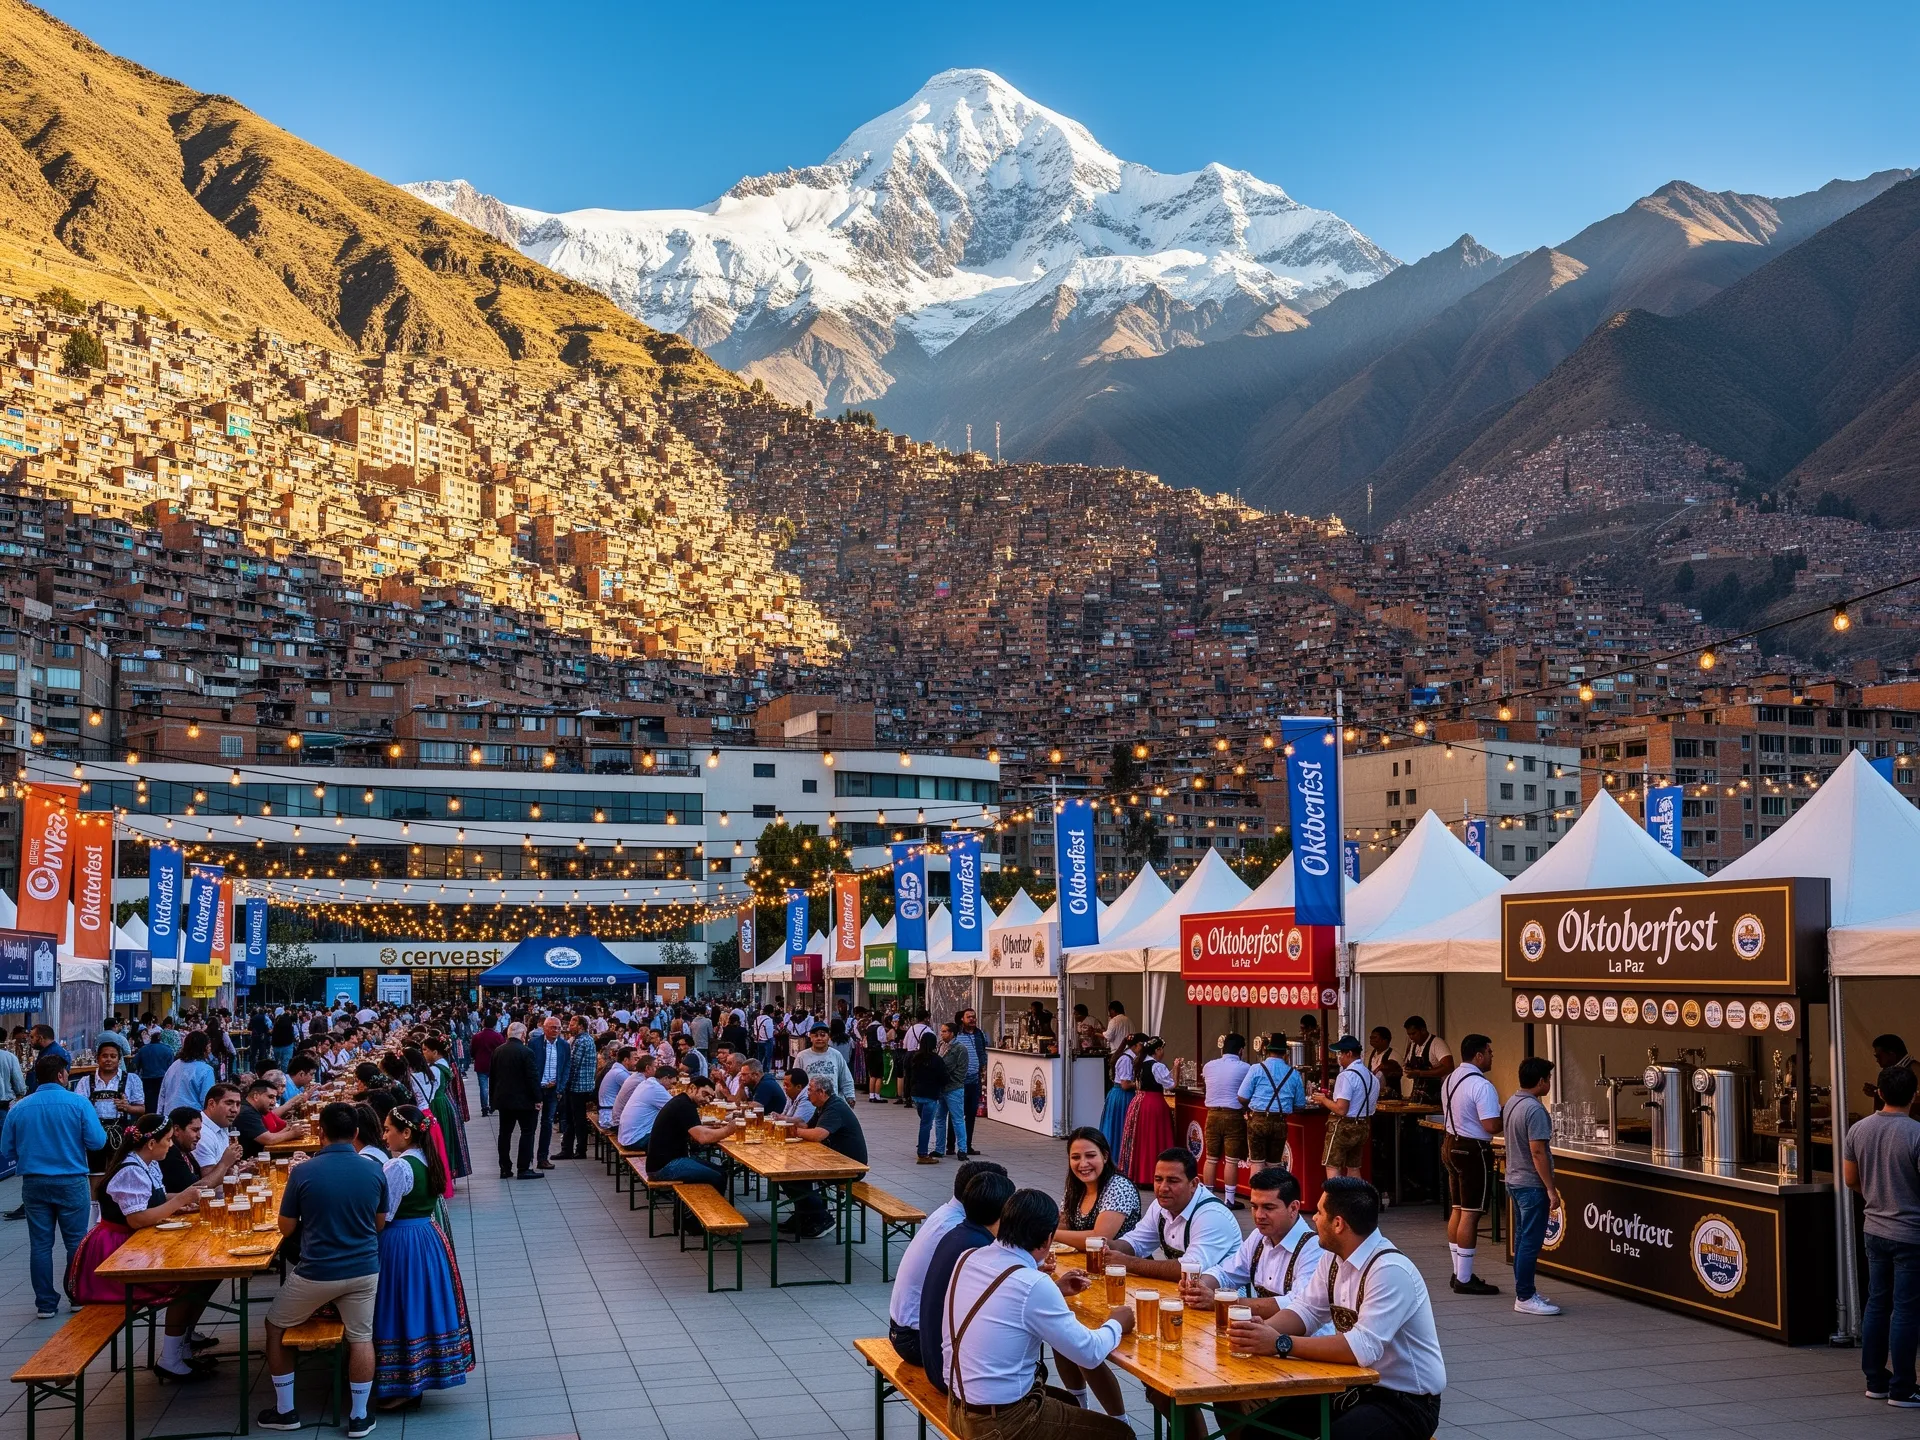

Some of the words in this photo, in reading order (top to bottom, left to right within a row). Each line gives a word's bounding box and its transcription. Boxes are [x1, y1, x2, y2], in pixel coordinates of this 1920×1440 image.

[1557, 907, 1718, 965] Oktoberfest
[1207, 924, 1284, 965] Oktoberfest
[1231, 958, 1240, 968] La
[1609, 959, 1622, 973] La
[1624, 959, 1644, 973] Paz
[1623, 1242, 1641, 1258] Paz
